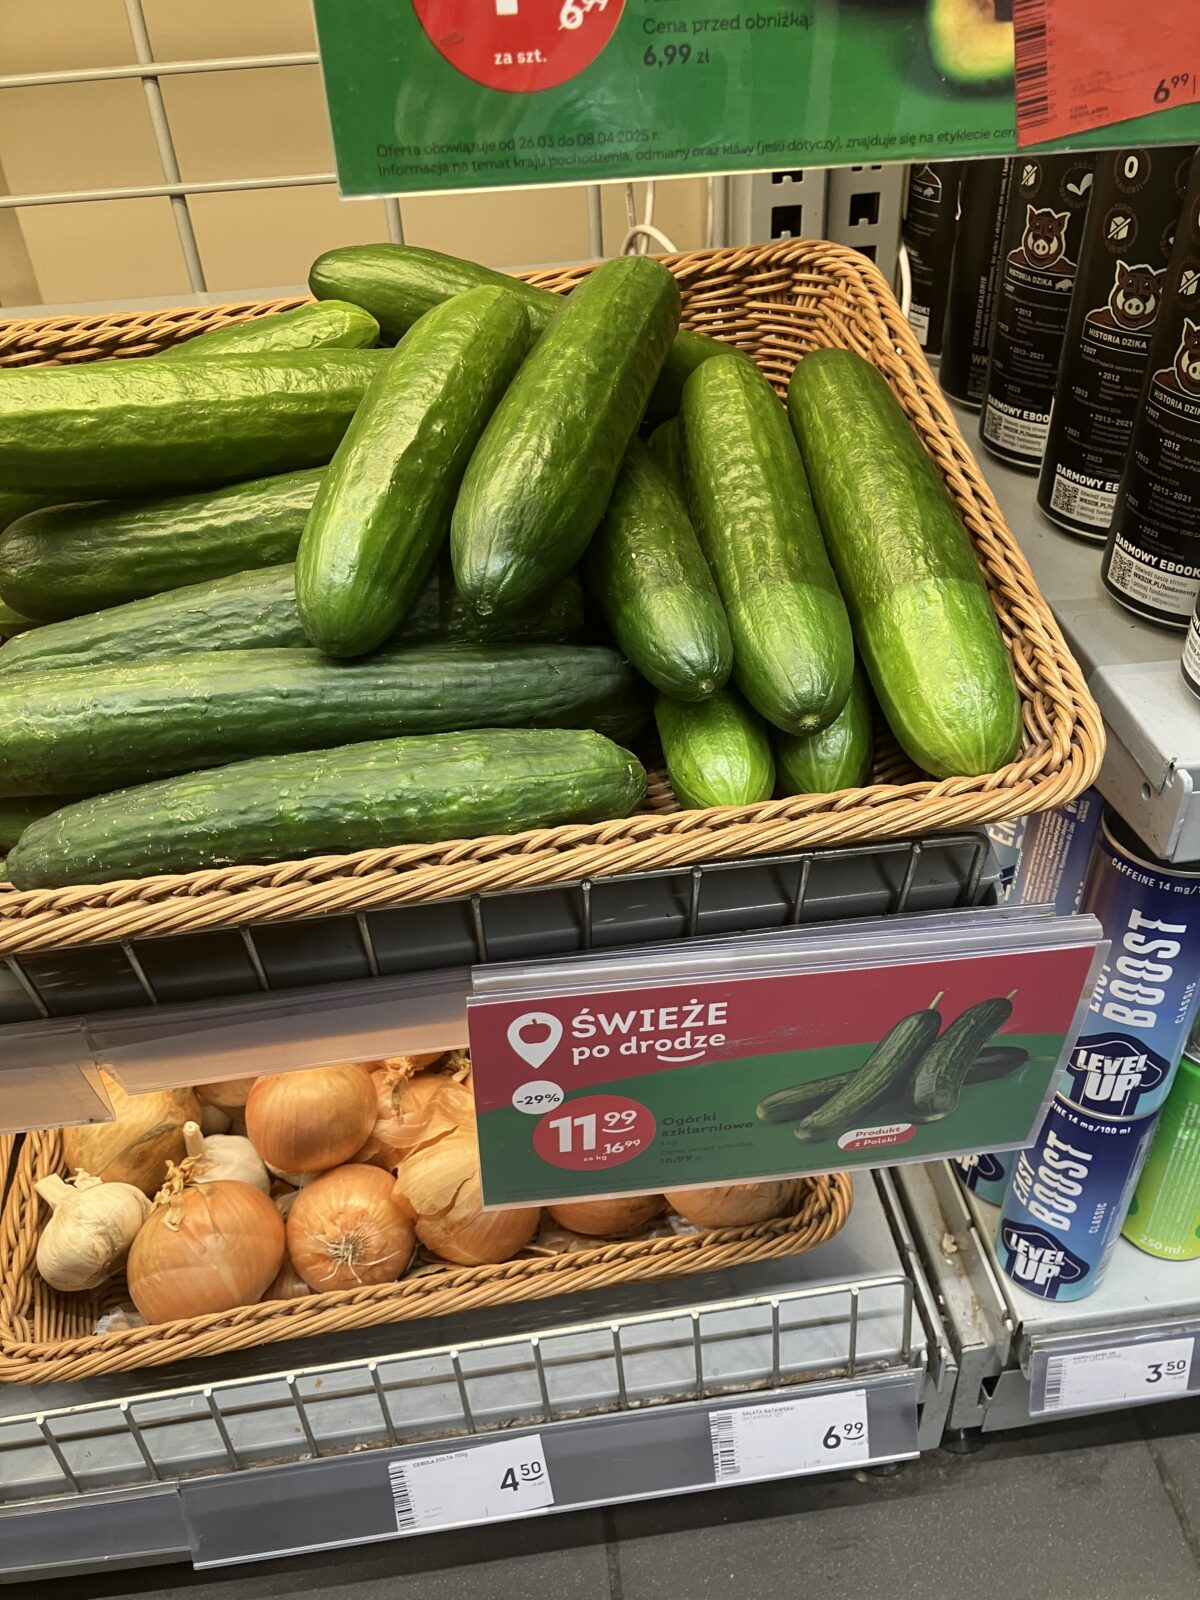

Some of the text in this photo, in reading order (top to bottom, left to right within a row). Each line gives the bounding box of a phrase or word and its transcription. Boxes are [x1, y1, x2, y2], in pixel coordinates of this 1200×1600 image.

[642, 11, 815, 36] Cena przed obniżką:
[495, 49, 547, 65] za szt.
[643, 44, 710, 68] 6,99 zł
[376, 144, 422, 158] Oferta
[499, 138, 515, 151] od
[557, 134, 575, 147] do
[378, 162, 449, 176] Informacja
[452, 161, 469, 173] na
[472, 158, 510, 172] temat
[513, 156, 545, 171] kraju
[635, 147, 691, 162] odmiany
[692, 146, 719, 157] oraz
[846, 134, 896, 150] znajduje
[899, 132, 916, 147] się
[919, 133, 935, 145] na
[937, 129, 991, 145] etykiecie
[1088, 327, 1147, 349] HISTORIA DZIKA
[1103, 372, 1121, 383] 2012
[1154, 389, 1183, 411] HISTORIA
[1163, 439, 1180, 452] 2012
[1056, 463, 1104, 490] DARMOWY
[1142, 525, 1160, 539] 2023
[1115, 531, 1159, 566] DARMOWY
[1111, 857, 1156, 887] CAFFEINE
[1159, 880, 1171, 892] 14
[1102, 908, 1187, 1029] BOOST
[1174, 981, 1197, 1025] CLASSIC
[571, 998, 728, 1039] ŚWIEŻE
[572, 1031, 727, 1067] po drodze
[1076, 1048, 1148, 1075] LEVEL
[1084, 1072, 1142, 1101] UP
[516, 1093, 561, 1106] -29%
[661, 1121, 754, 1138] szklarniowe
[662, 1112, 717, 1127] Ogórki
[1068, 1114, 1079, 1125] 14
[1079, 1121, 1117, 1135] mg/100
[1119, 1126, 1132, 1135] ml
[855, 1126, 901, 1138] Produkt
[863, 1135, 897, 1147] Polski
[595, 1154, 608, 1162] kg
[1012, 1149, 1036, 1207] EASY
[1028, 1129, 1094, 1232] BOOST
[1010, 1231, 1066, 1266] LEVEL
[1014, 1253, 1061, 1286] UP
[412, 1459, 435, 1469] CEBULA
